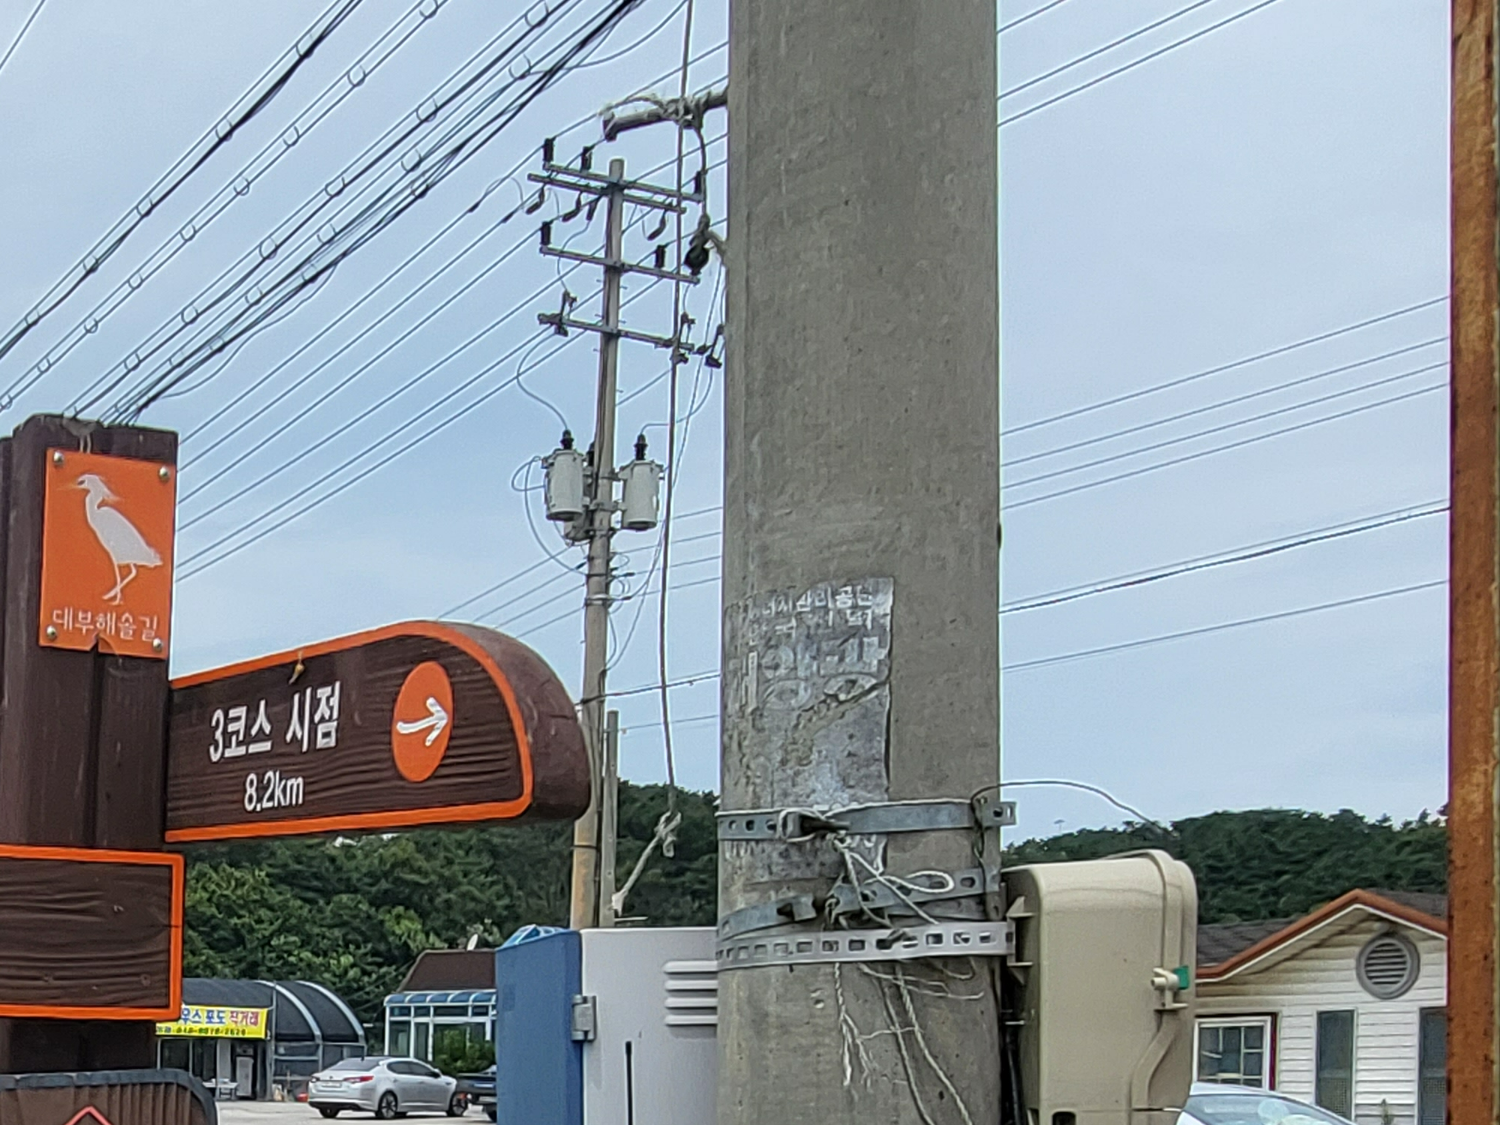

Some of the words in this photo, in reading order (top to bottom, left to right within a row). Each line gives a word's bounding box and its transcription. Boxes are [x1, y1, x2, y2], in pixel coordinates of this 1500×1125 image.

[52, 608, 159, 642] 대부해솔길
[209, 697, 273, 763] 3코스
[286, 680, 341, 753] 시점
[244, 771, 304, 812] 8.2km
